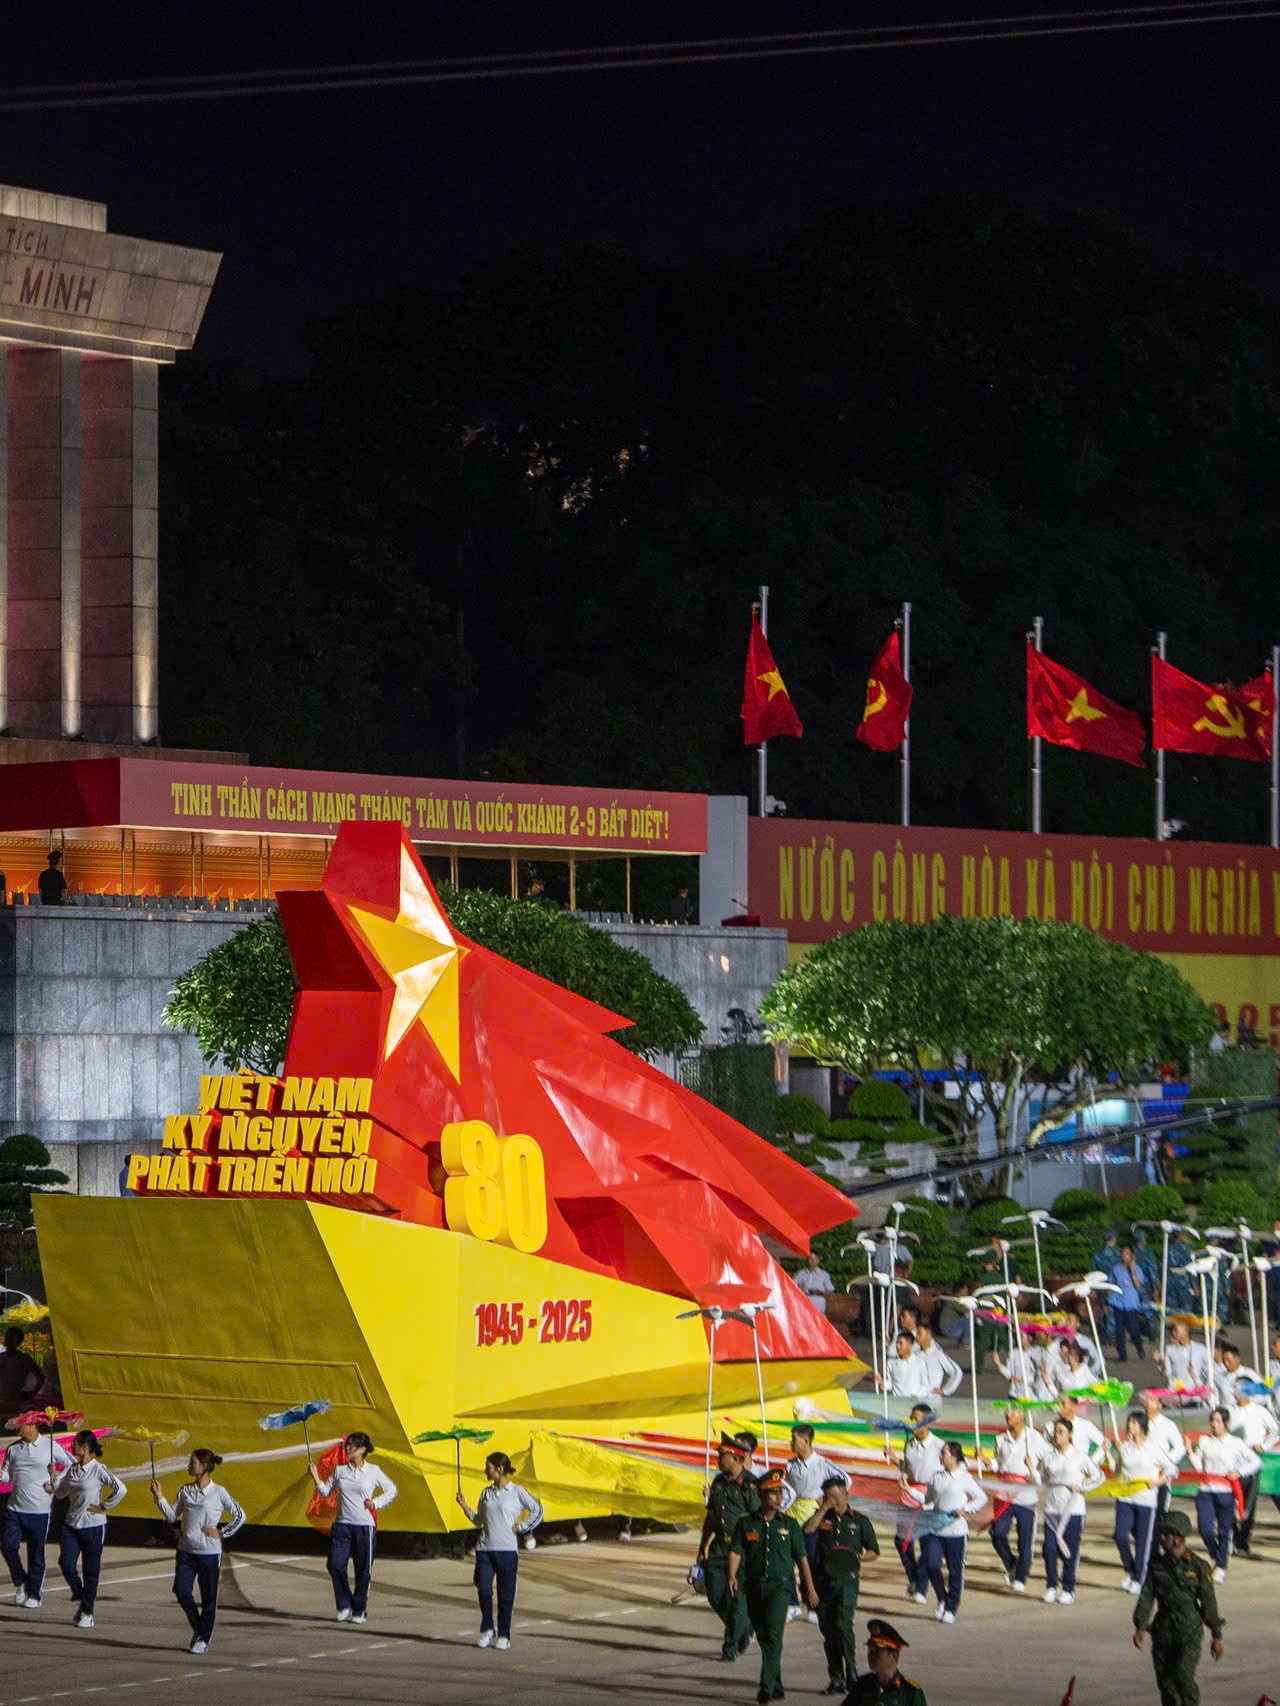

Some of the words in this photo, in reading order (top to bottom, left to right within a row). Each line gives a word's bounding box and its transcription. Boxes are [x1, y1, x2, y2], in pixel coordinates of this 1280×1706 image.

[20, 260, 96, 314] MINH
[171, 782, 212, 816] TINH
[217, 776, 261, 819] THẦN
[266, 782, 307, 822] CÁCH
[312, 791, 355, 830] MẠNG
[360, 789, 411, 827] THÁNG
[416, 792, 448, 829] TÁM
[453, 793, 472, 831] VÀ
[476, 793, 513, 834] QUỐC
[517, 798, 566, 835] KHÁNH
[570, 806, 595, 837] 2-9
[599, 800, 627, 838] BẤT
[779, 835, 855, 924] NƯỚC
[962, 843, 1011, 920] HÒA
[199, 1068, 278, 1114] VIỆT
[281, 1077, 373, 1112] NAM
[162, 1104, 212, 1150] KỶ
[219, 1111, 373, 1154] NGUYÊN
[126, 1150, 212, 1190] PHÁT
[218, 1145, 310, 1192] TRIỂN
[311, 1153, 377, 1194] MỚI
[440, 1119, 548, 1253] 80
[474, 1302, 524, 1346] 1945
[539, 1299, 592, 1343] 2025
